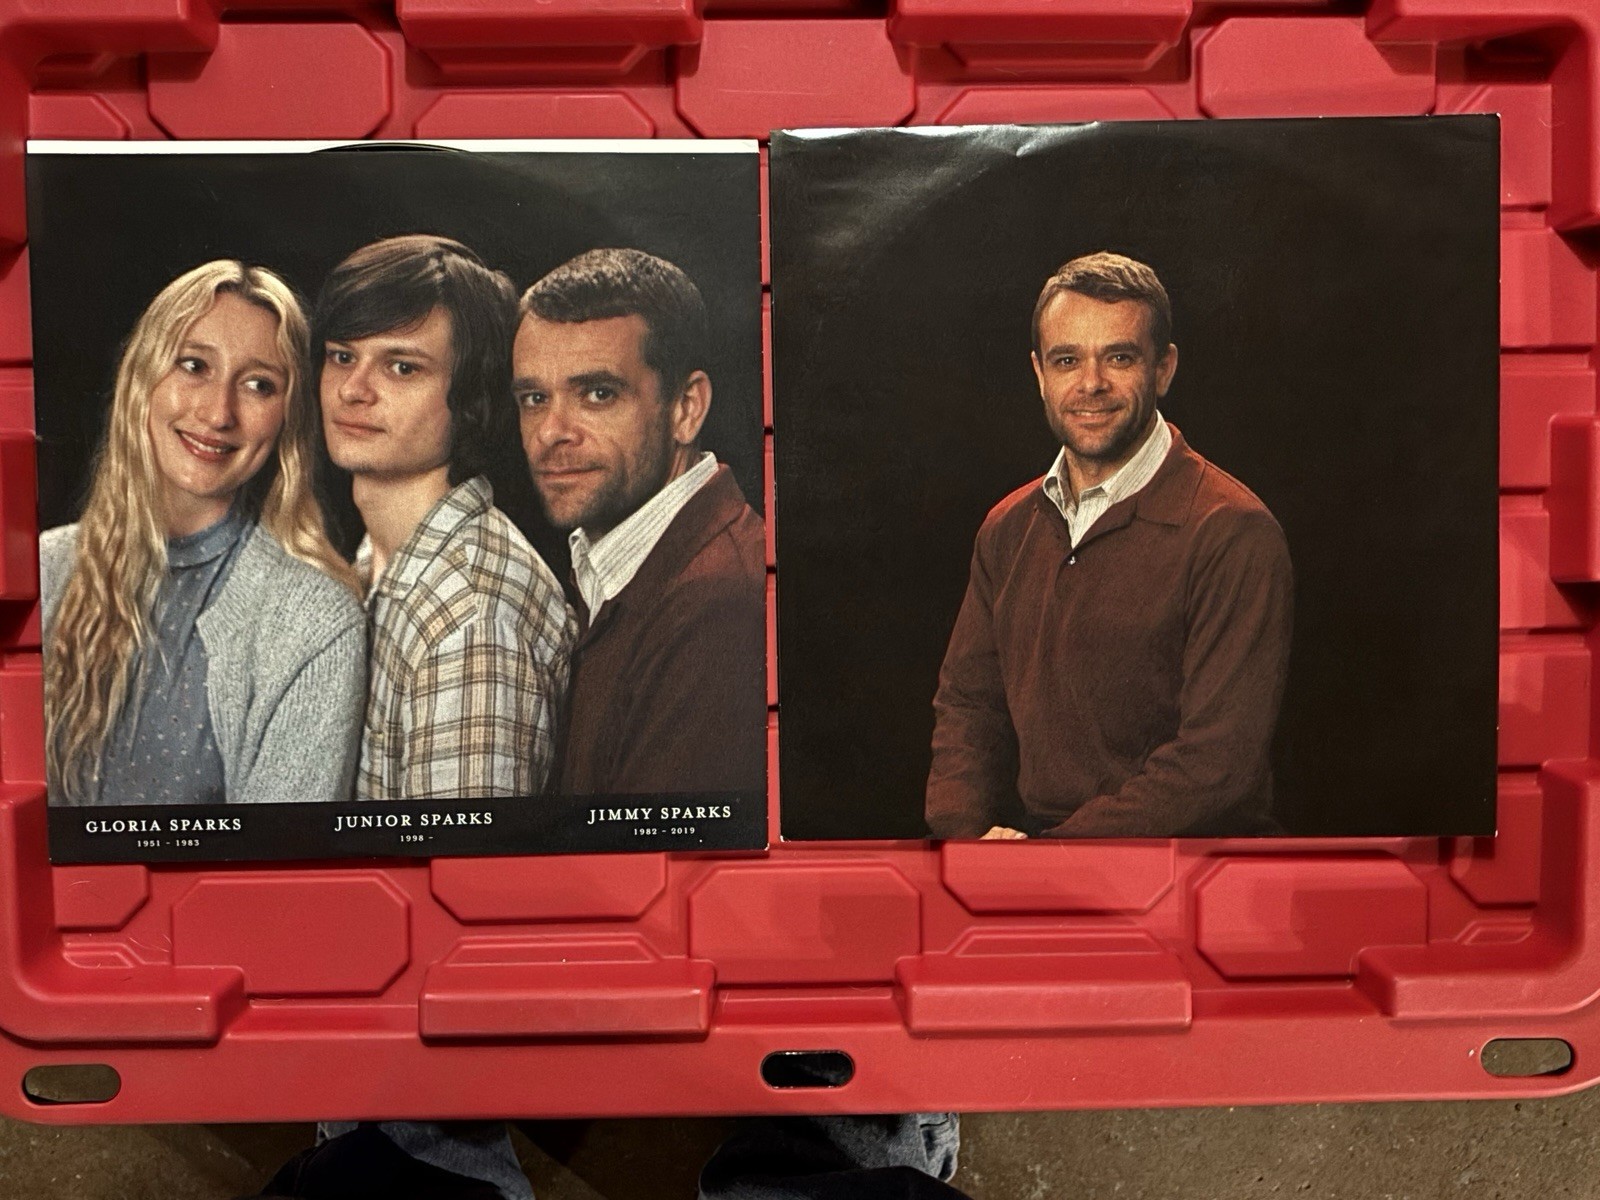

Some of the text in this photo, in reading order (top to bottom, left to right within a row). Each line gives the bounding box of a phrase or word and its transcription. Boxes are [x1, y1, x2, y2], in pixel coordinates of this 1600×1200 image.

[588, 806, 731, 824] JIMMY SPARKS
[86, 819, 241, 832] GLORIA SPARKS
[335, 812, 492, 831] JUNIOR SPARKS
[633, 827, 658, 836] 1982
[670, 826, 696, 835] 2019
[137, 839, 161, 848] 1951
[175, 839, 200, 847] 1983
[400, 834, 424, 843] 1998
